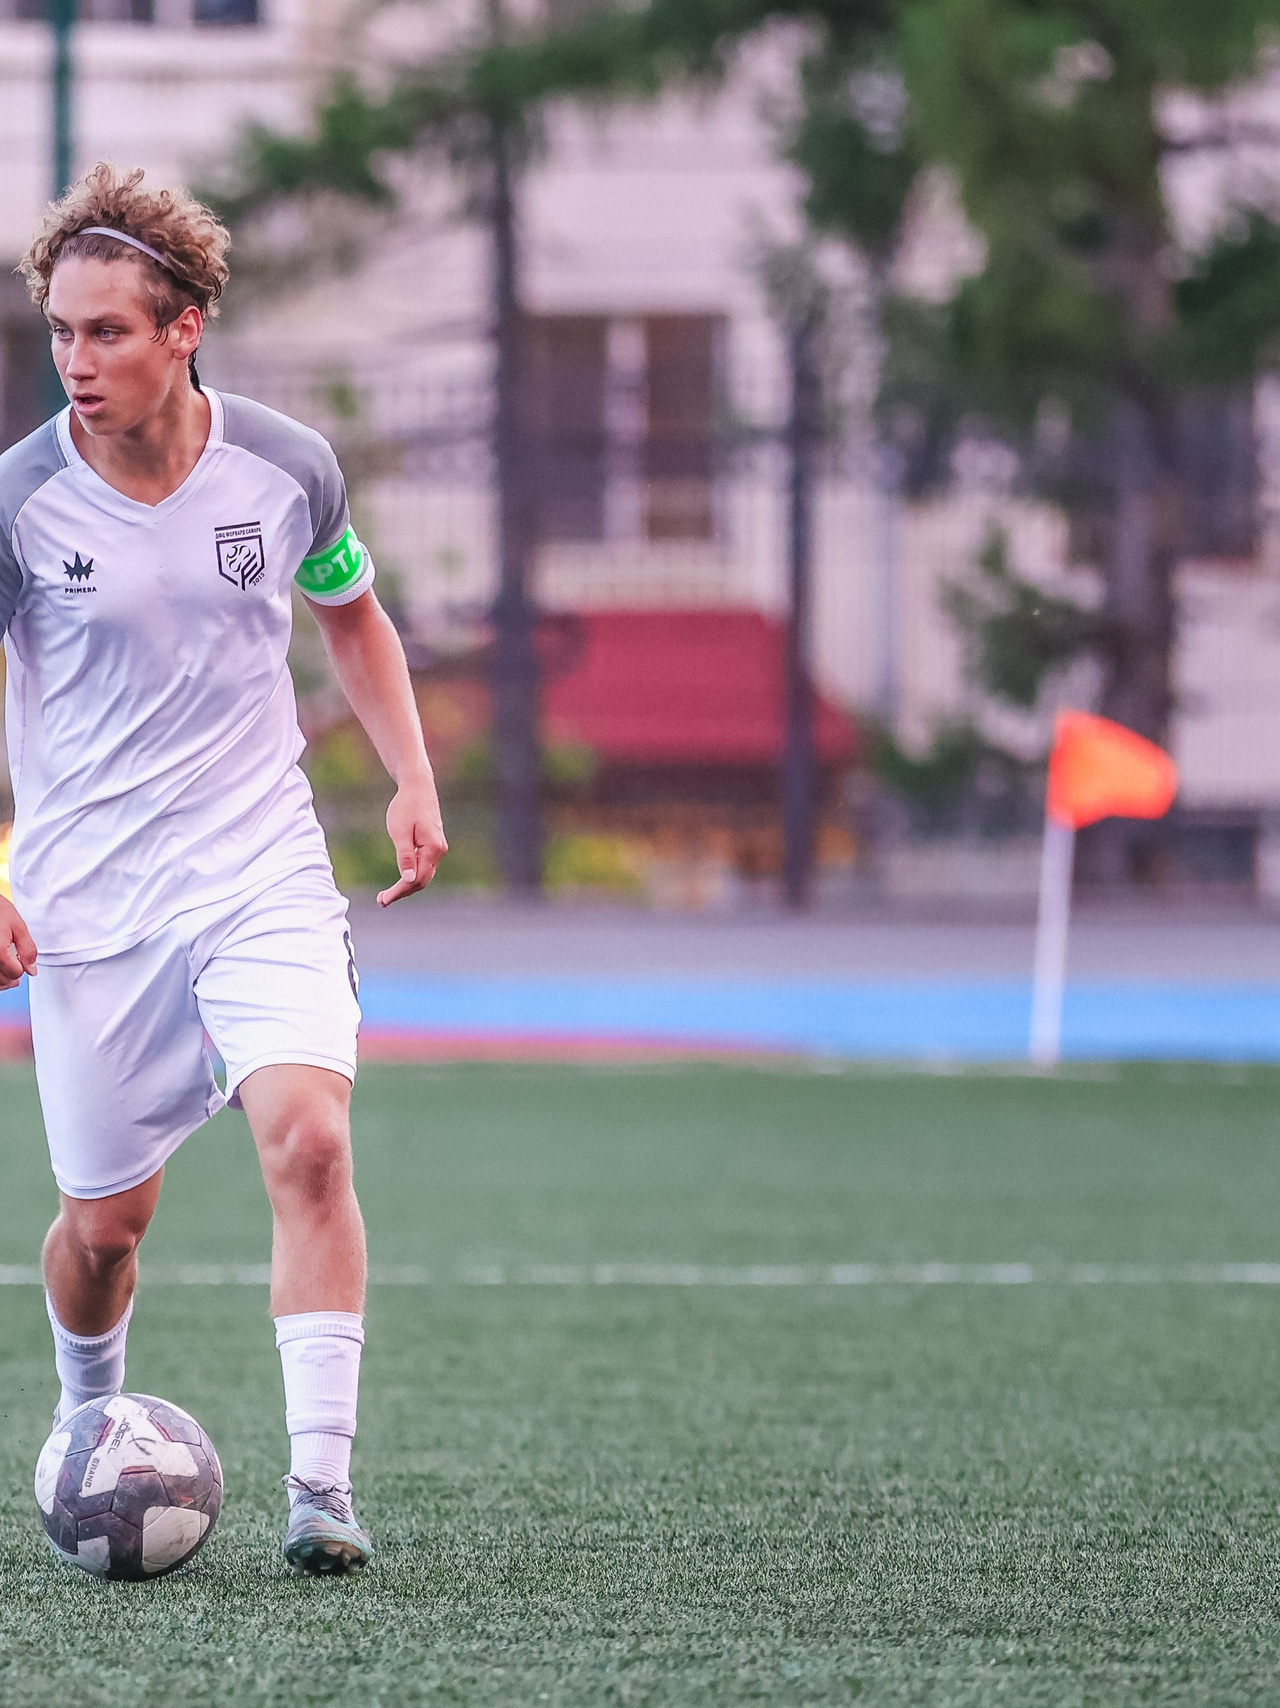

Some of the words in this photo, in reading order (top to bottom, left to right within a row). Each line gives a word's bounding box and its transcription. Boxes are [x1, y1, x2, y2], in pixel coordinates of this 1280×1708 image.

[226, 529, 246, 537] ФОРВАРД
[252, 572, 265, 587] 2015
[64, 586, 98, 594] PRIMERA
[84, 1457, 100, 1488] GRAND
